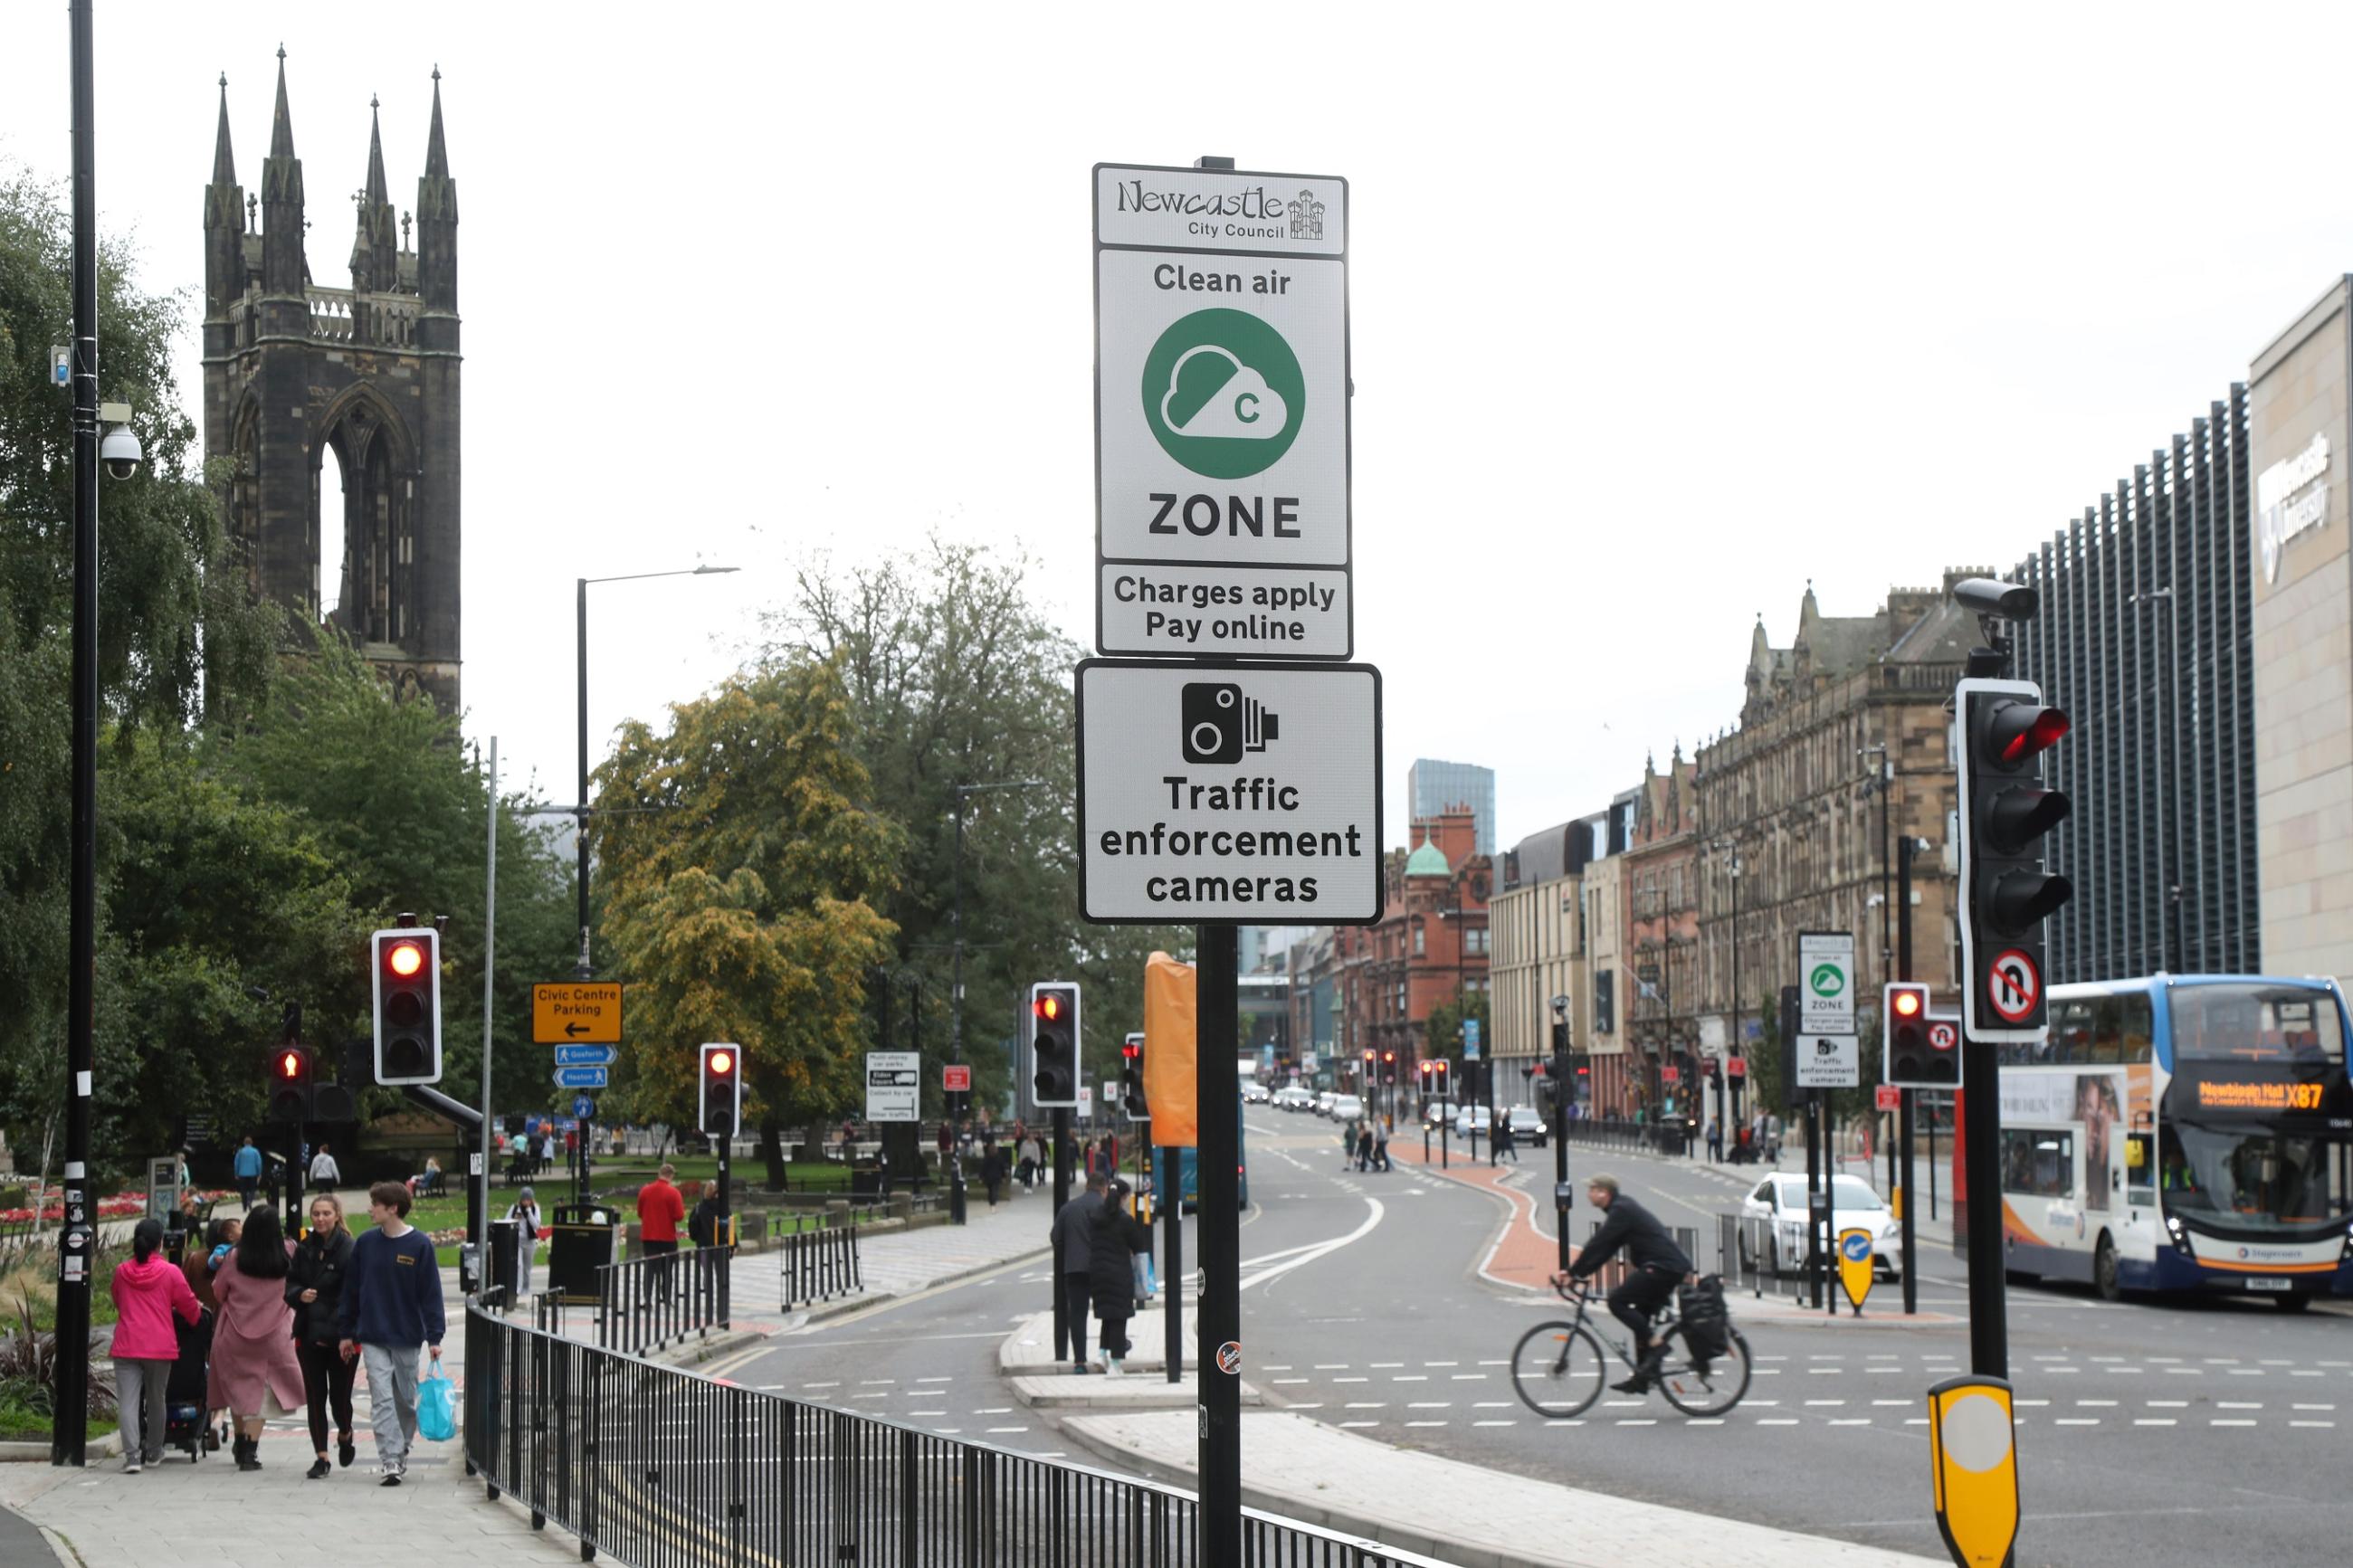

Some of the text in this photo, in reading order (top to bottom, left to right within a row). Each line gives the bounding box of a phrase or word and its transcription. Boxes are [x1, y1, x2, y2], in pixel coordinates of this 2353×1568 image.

[1118, 180, 1283, 220] Newcastle
[1188, 223, 1283, 238] City Council
[1154, 264, 1291, 294] Clean air
[1234, 393, 1260, 423] C
[1149, 493, 1300, 537] ZONE
[1114, 576, 1335, 612] Charges apply
[1147, 612, 1304, 642] Pay online
[1163, 776, 1299, 811] Traffic
[1100, 822, 1361, 857] enforcement
[1146, 877, 1318, 902] cameras
[538, 989, 616, 1001] Civic Centre
[554, 1003, 601, 1017] Parking
[1812, 1001, 1843, 1010] ZONE
[571, 1050, 604, 1058] Gosforth
[2286, 1083, 2323, 1109] X87
